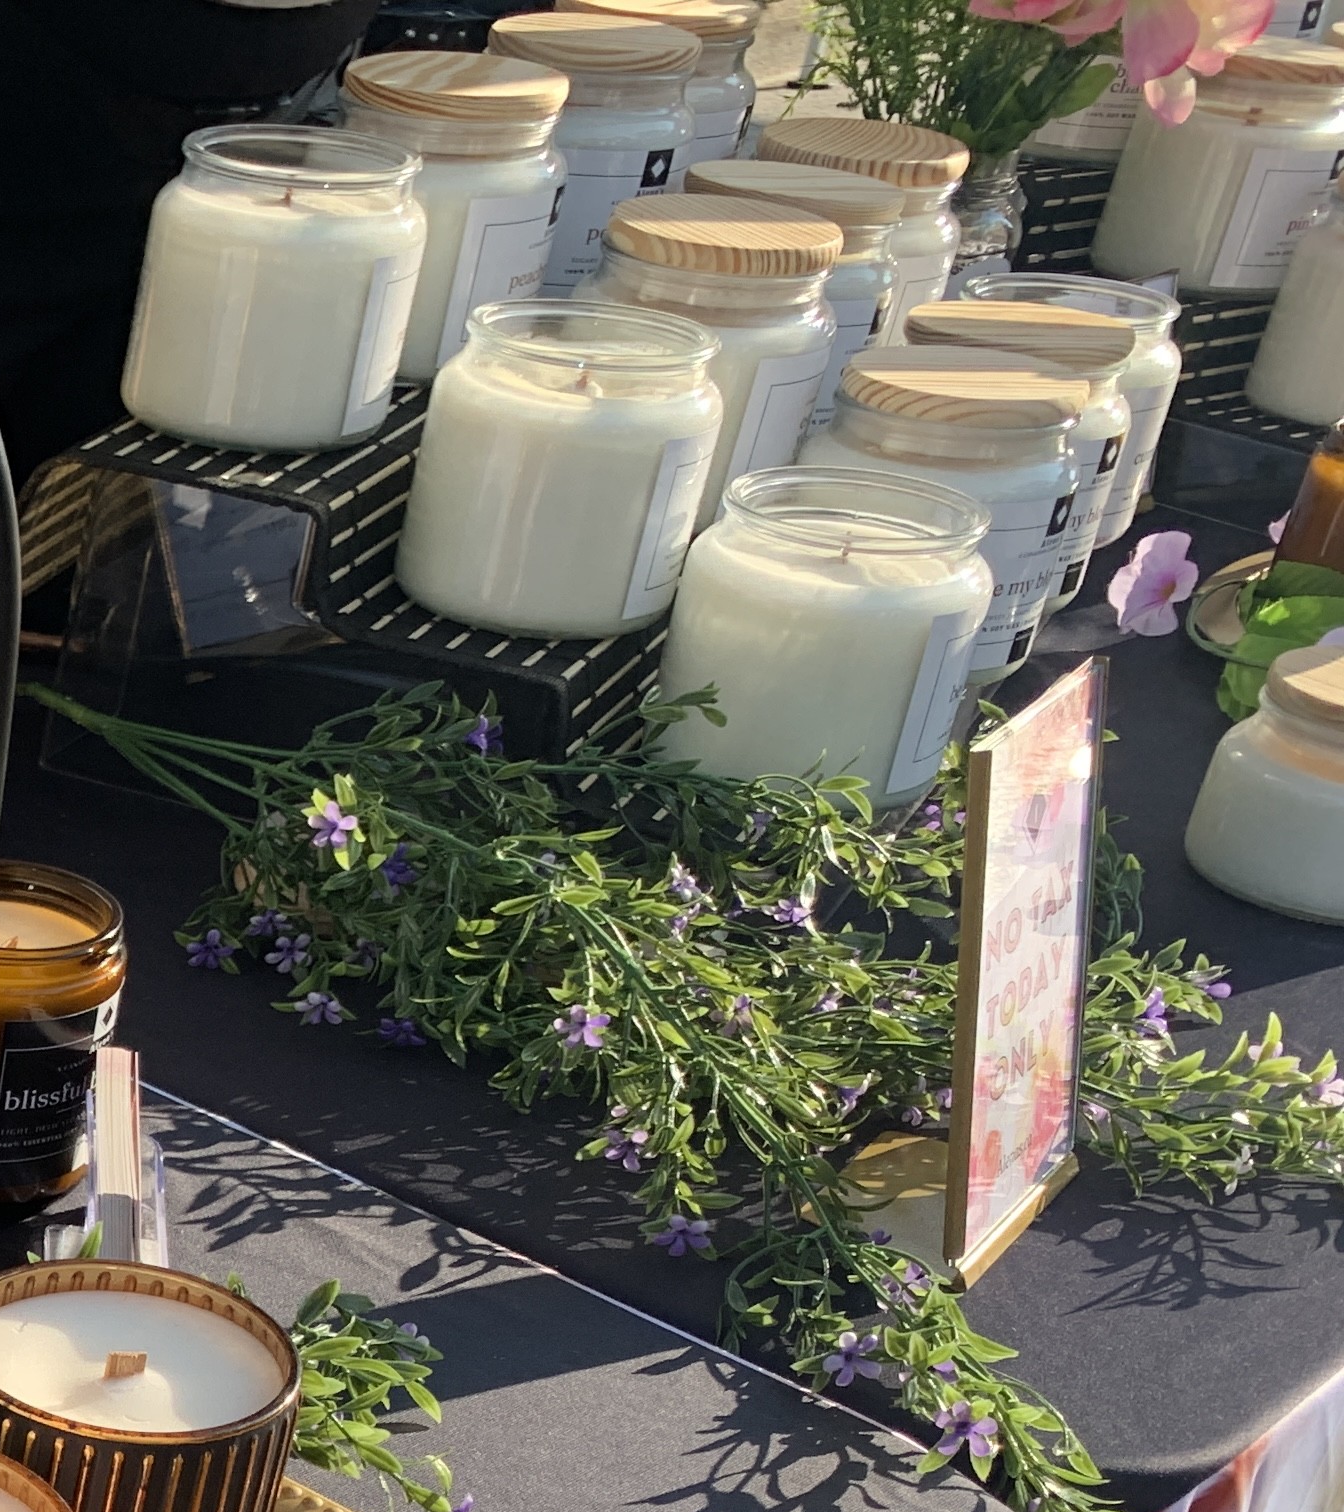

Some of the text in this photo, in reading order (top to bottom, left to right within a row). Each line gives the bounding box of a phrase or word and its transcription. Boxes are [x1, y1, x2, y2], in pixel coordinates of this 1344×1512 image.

[985, 860, 1075, 972] NO TAX
[986, 932, 1067, 1041] TODAY
[4, 1075, 88, 1111] blissful
[988, 1009, 1055, 1101] ONLY
